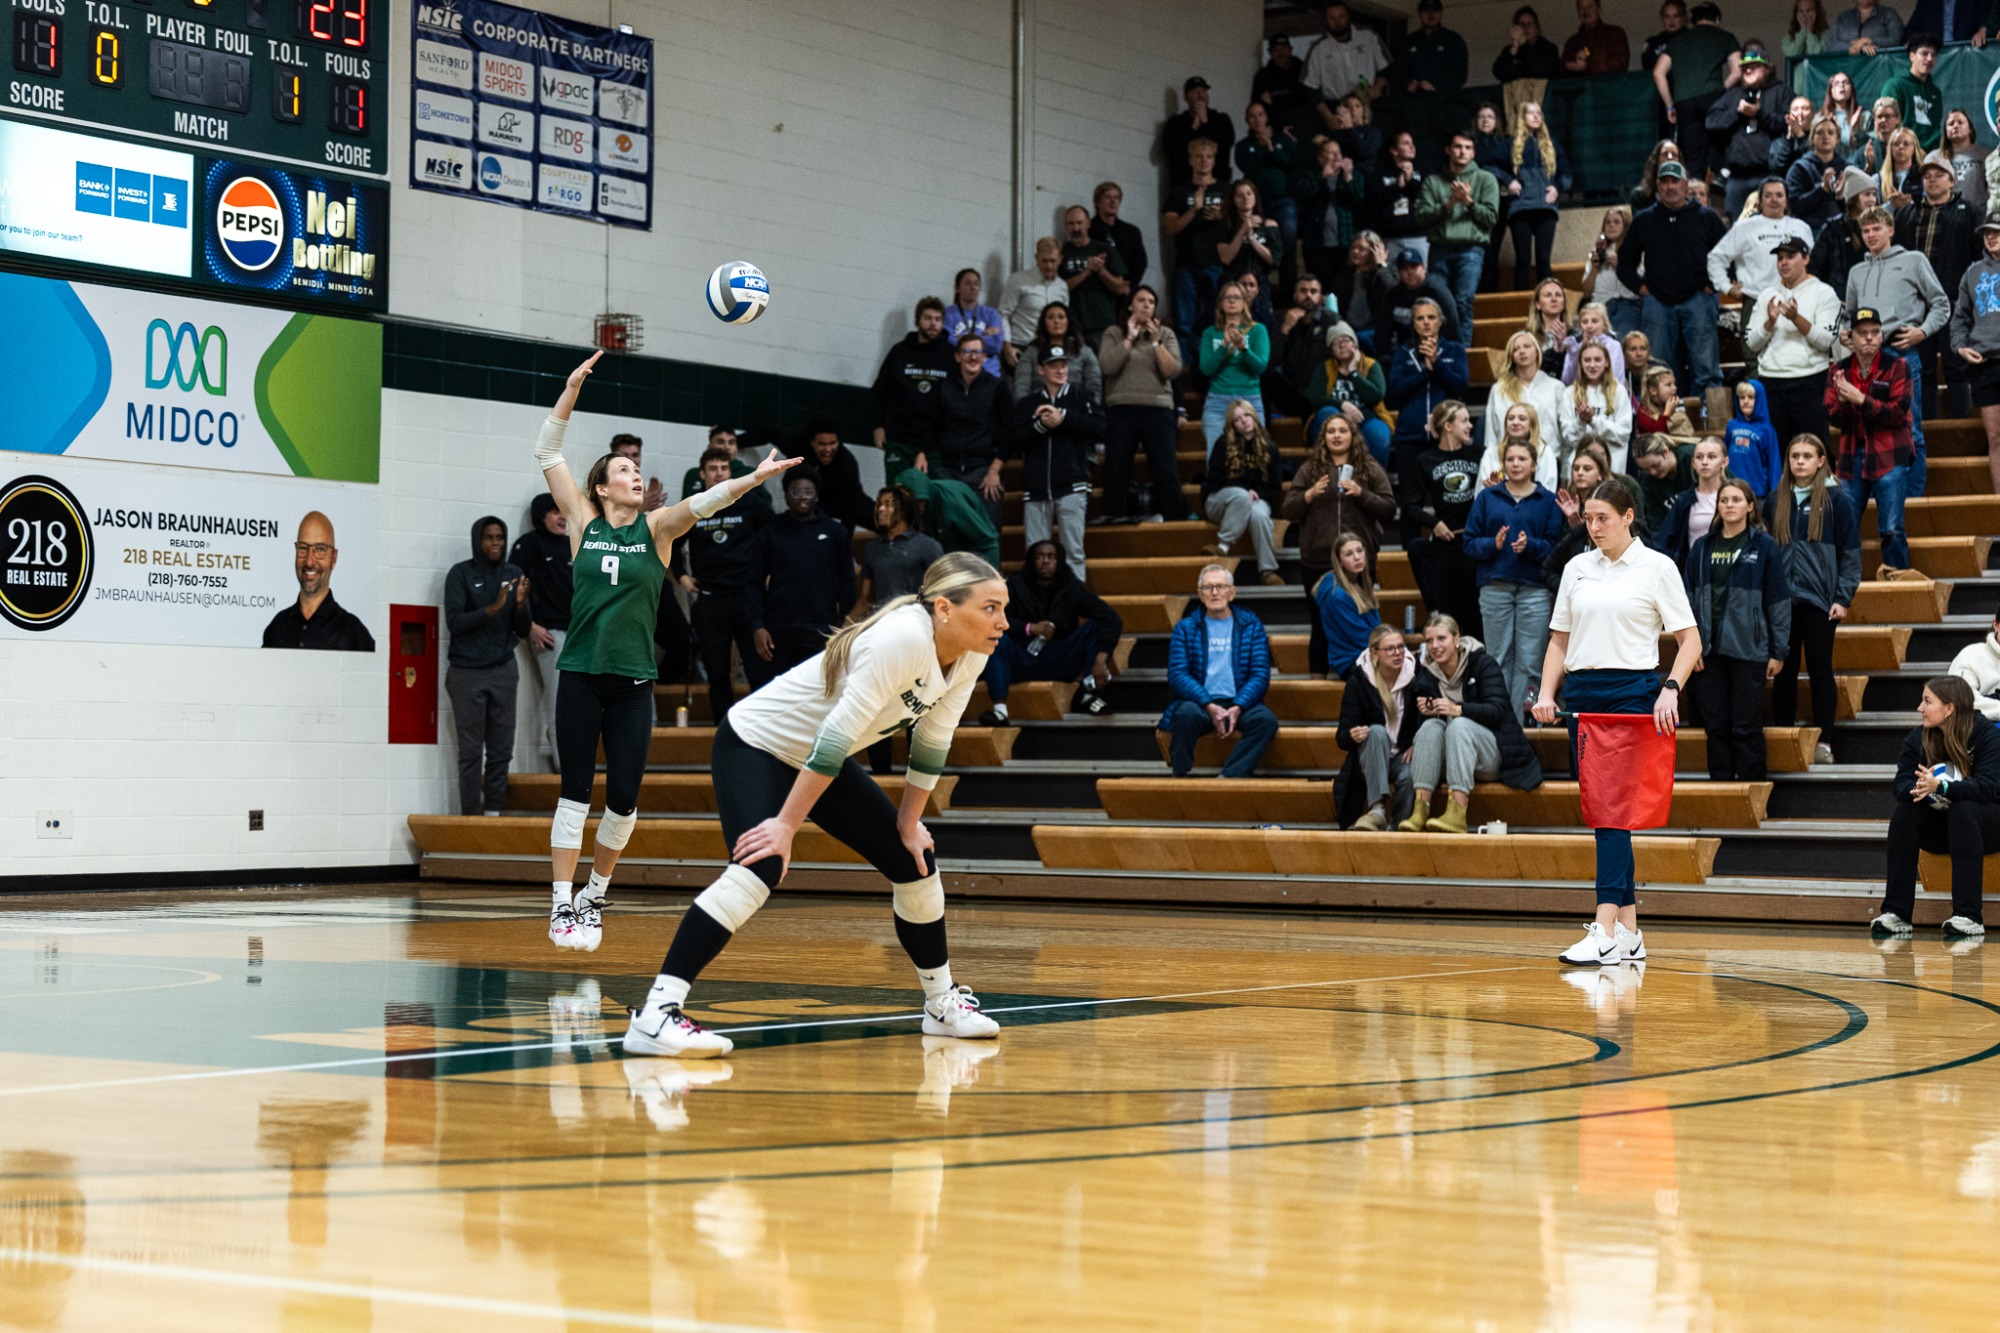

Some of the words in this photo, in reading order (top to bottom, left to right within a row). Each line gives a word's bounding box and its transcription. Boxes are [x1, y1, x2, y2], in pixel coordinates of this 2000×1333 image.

[12, 0, 66, 15] ULS
[85, 0, 130, 29] T.O.L.
[147, 14, 206, 45] PLAYER
[215, 28, 253, 56] FOUL
[310, 0, 366, 47] 23
[50, 25, 56, 68] 1
[96, 31, 118, 83] 0
[268, 40, 309, 67] T.O.L.
[472, 19, 569, 56] CORPORATE
[572, 43, 649, 74] PARTNERS
[325, 53, 371, 79] FOULS
[419, 50, 469, 71] SANFORD
[485, 59, 523, 80] MIDCO
[10, 82, 64, 111] SCORE
[293, 75, 299, 116] 1
[485, 75, 527, 97] SPORTS
[556, 81, 589, 100] gpac
[358, 89, 364, 129] 1
[431, 109, 471, 124] HOMETOWN
[174, 112, 228, 140] MATCH
[489, 130, 522, 143] MAMMOTH
[325, 141, 371, 168] SCORE
[79, 180, 104, 191] BANK
[79, 189, 110, 199] FORWARD
[117, 186, 143, 197] INVEST
[548, 185, 582, 202] FARGO
[117, 194, 148, 205] FORWARD
[222, 210, 279, 236] PEPSI
[307, 190, 357, 240] Nei
[9, 225, 22, 234] you
[23, 227, 31, 235] to
[32, 229, 46, 237] join
[47, 231, 59, 239] our
[61, 233, 83, 243] team?
[293, 237, 376, 281] Bottling
[328, 282, 374, 296] MINNESOTA
[126, 402, 239, 449] MIDCO
[93, 507, 153, 530] JASON
[157, 512, 279, 538] BRAUNHAUSEN
[7, 518, 68, 567] 218
[583, 541, 617, 551] BEMIDJI
[618, 543, 647, 553] STATE
[123, 548, 148, 565] 218
[152, 550, 192, 567] REAL
[196, 553, 251, 570] ESTATE
[600, 555, 620, 586] 9
[6, 568, 31, 586] REAL
[33, 570, 68, 588] ESTATE
[147, 571, 228, 588] (218)-760-7552
[94, 587, 276, 608] JMBRAUNHAUSEN@GMAIL.COM
